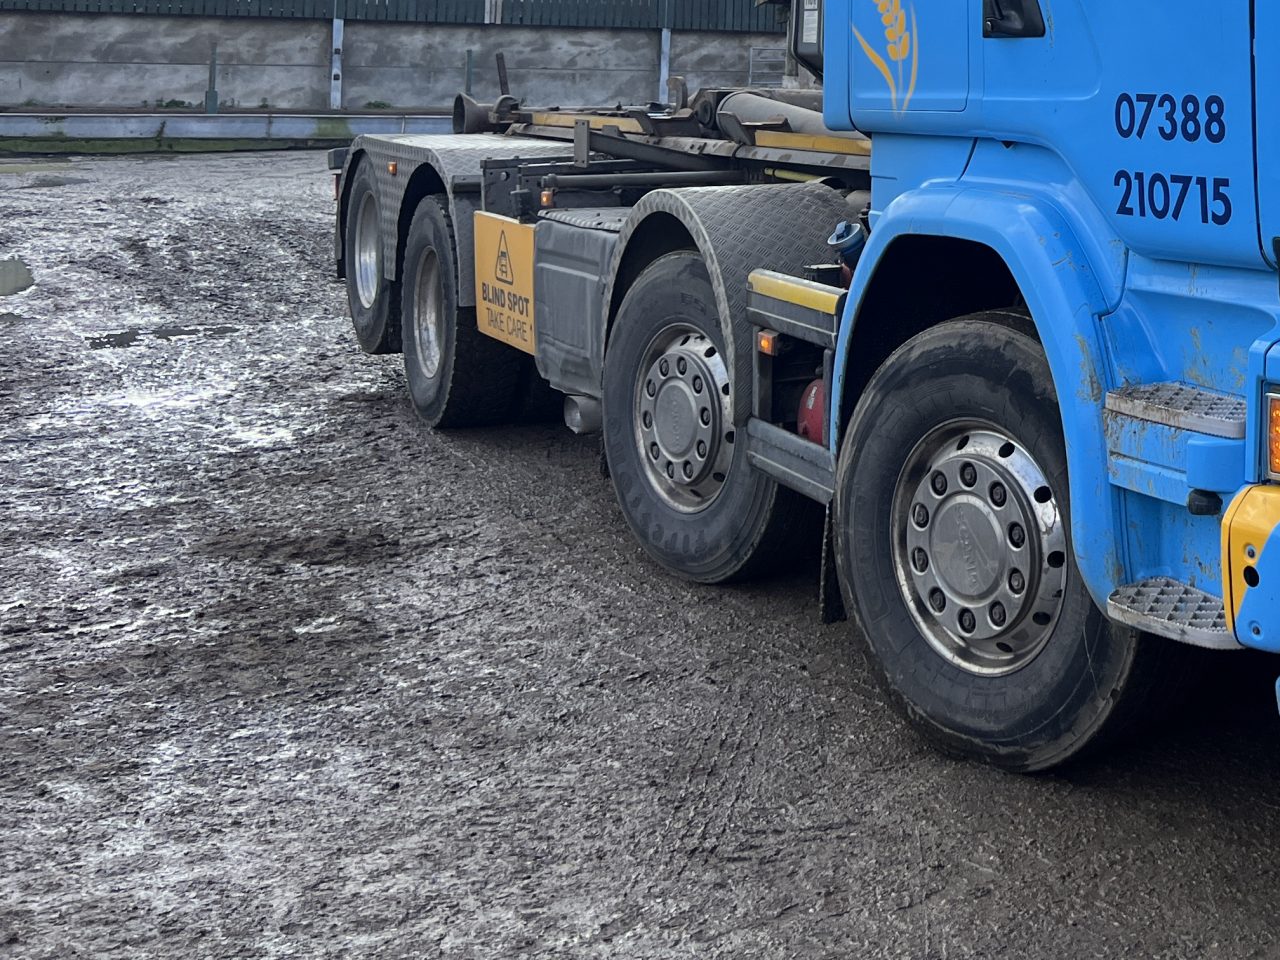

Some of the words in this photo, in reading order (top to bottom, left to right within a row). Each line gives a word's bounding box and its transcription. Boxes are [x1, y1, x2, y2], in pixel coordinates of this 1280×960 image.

[1114, 92, 1226, 144] 07388
[1113, 169, 1232, 226] 210715
[482, 282, 506, 308] BLIND
[507, 293, 530, 318] SPOT
[486, 307, 505, 333] TAKE
[506, 315, 528, 342] CARE
